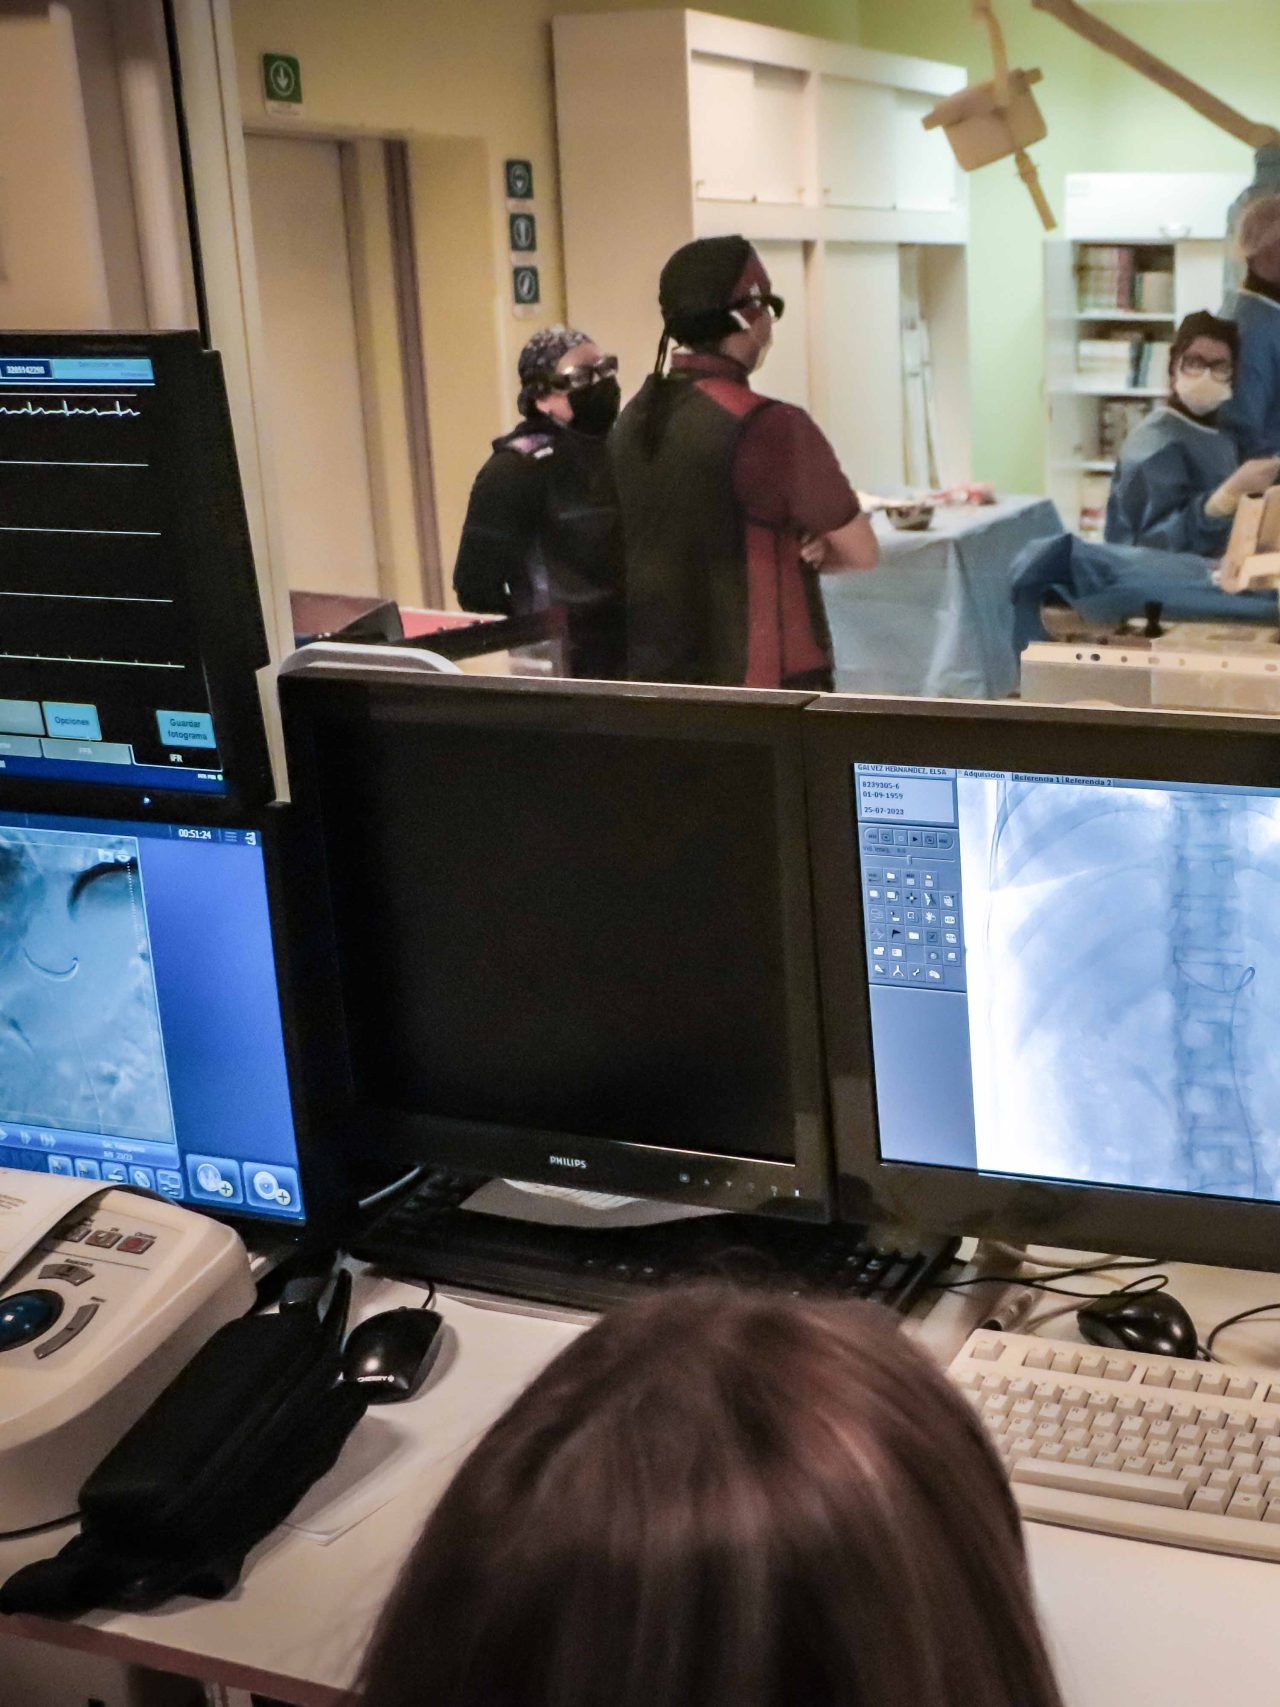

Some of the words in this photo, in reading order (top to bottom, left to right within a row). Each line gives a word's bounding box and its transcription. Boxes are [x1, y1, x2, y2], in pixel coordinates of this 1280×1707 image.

[54, 716, 90, 727] Opciones
[170, 718, 201, 728] Guardar
[168, 730, 208, 741] fotograma
[1014, 774, 1054, 783] Referencia
[1065, 778, 1105, 786] Referencia
[864, 806, 905, 815] 25-07-2023
[178, 828, 212, 840] 00:51:24
[549, 1155, 587, 1169] PHILIPS
